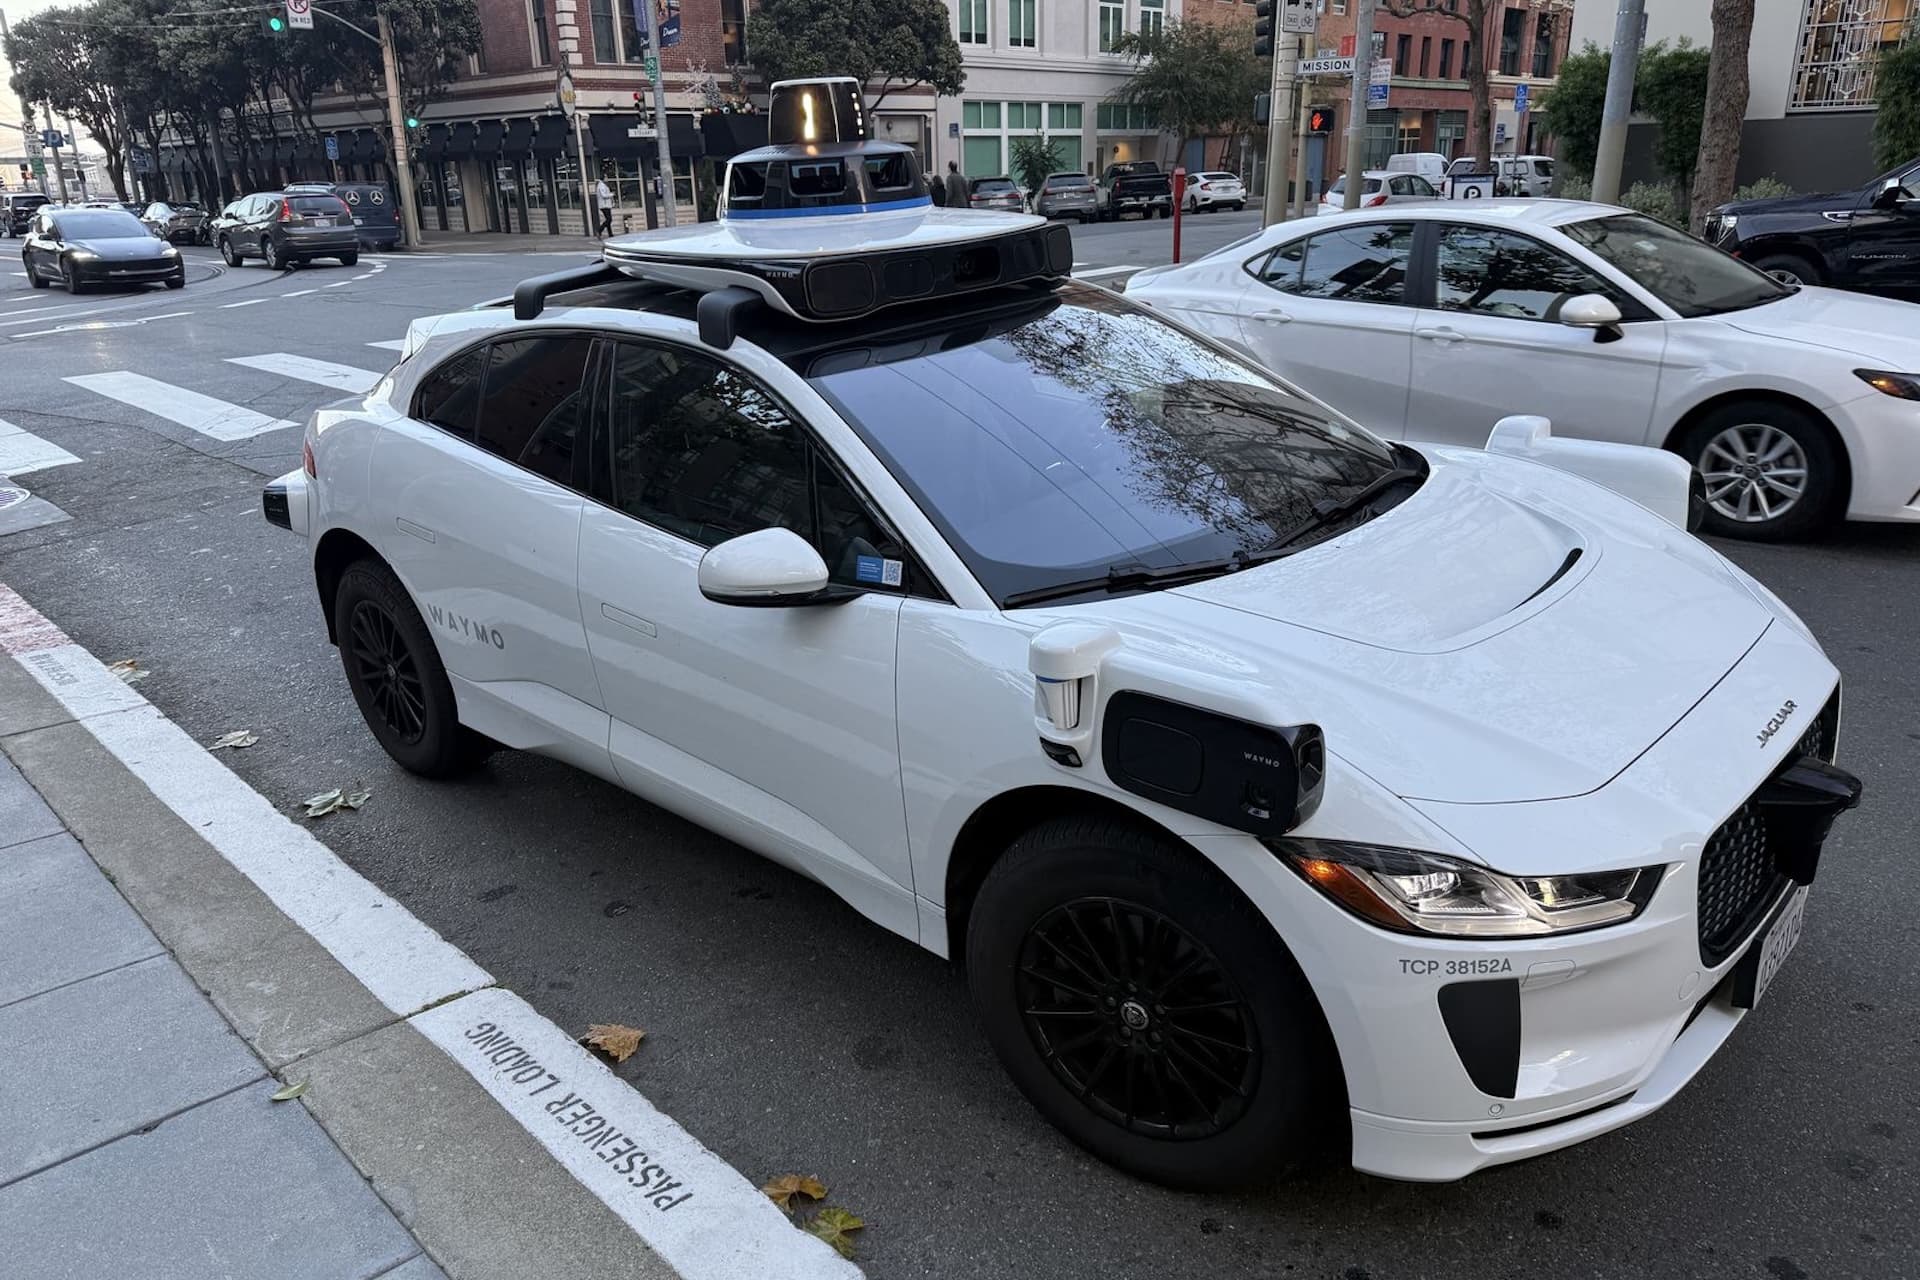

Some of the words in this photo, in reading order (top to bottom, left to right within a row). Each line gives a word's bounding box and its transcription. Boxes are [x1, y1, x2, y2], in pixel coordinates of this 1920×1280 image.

[1302, 60, 1351, 72] MISSION
[765, 270, 794, 278] WAYMO
[427, 602, 505, 650] WAYMO
[1756, 699, 1799, 749] JAGUAR
[1243, 751, 1280, 768] WAYMO
[1398, 959, 1440, 975] TCP
[1445, 957, 1513, 975] 38152A
[464, 1021, 561, 1097] LOADING
[545, 1092, 694, 1212] PASSENGER
